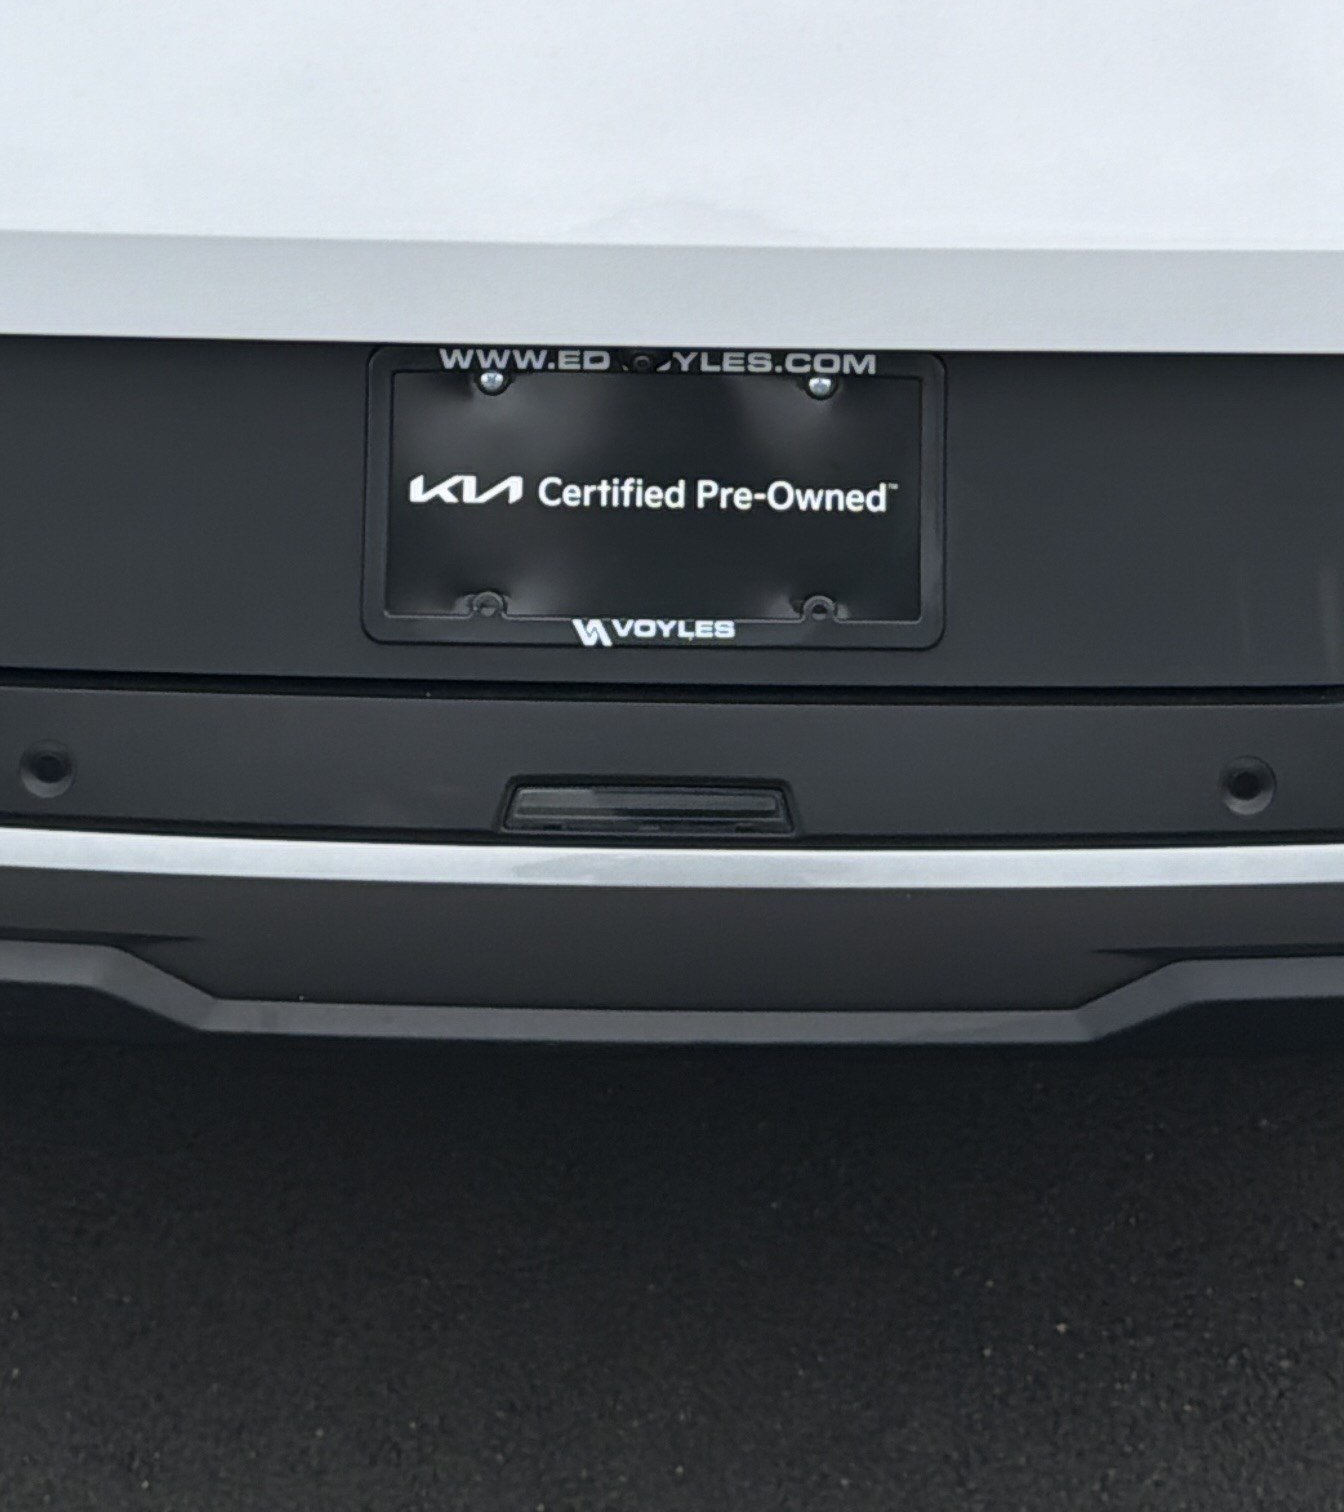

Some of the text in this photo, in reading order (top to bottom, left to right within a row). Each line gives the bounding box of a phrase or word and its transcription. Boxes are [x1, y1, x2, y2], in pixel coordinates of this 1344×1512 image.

[439, 347, 877, 375] WWW.EDYLES.COM
[408, 473, 524, 504] KIA
[537, 476, 686, 510] Certified
[611, 618, 736, 640] VOYLES
